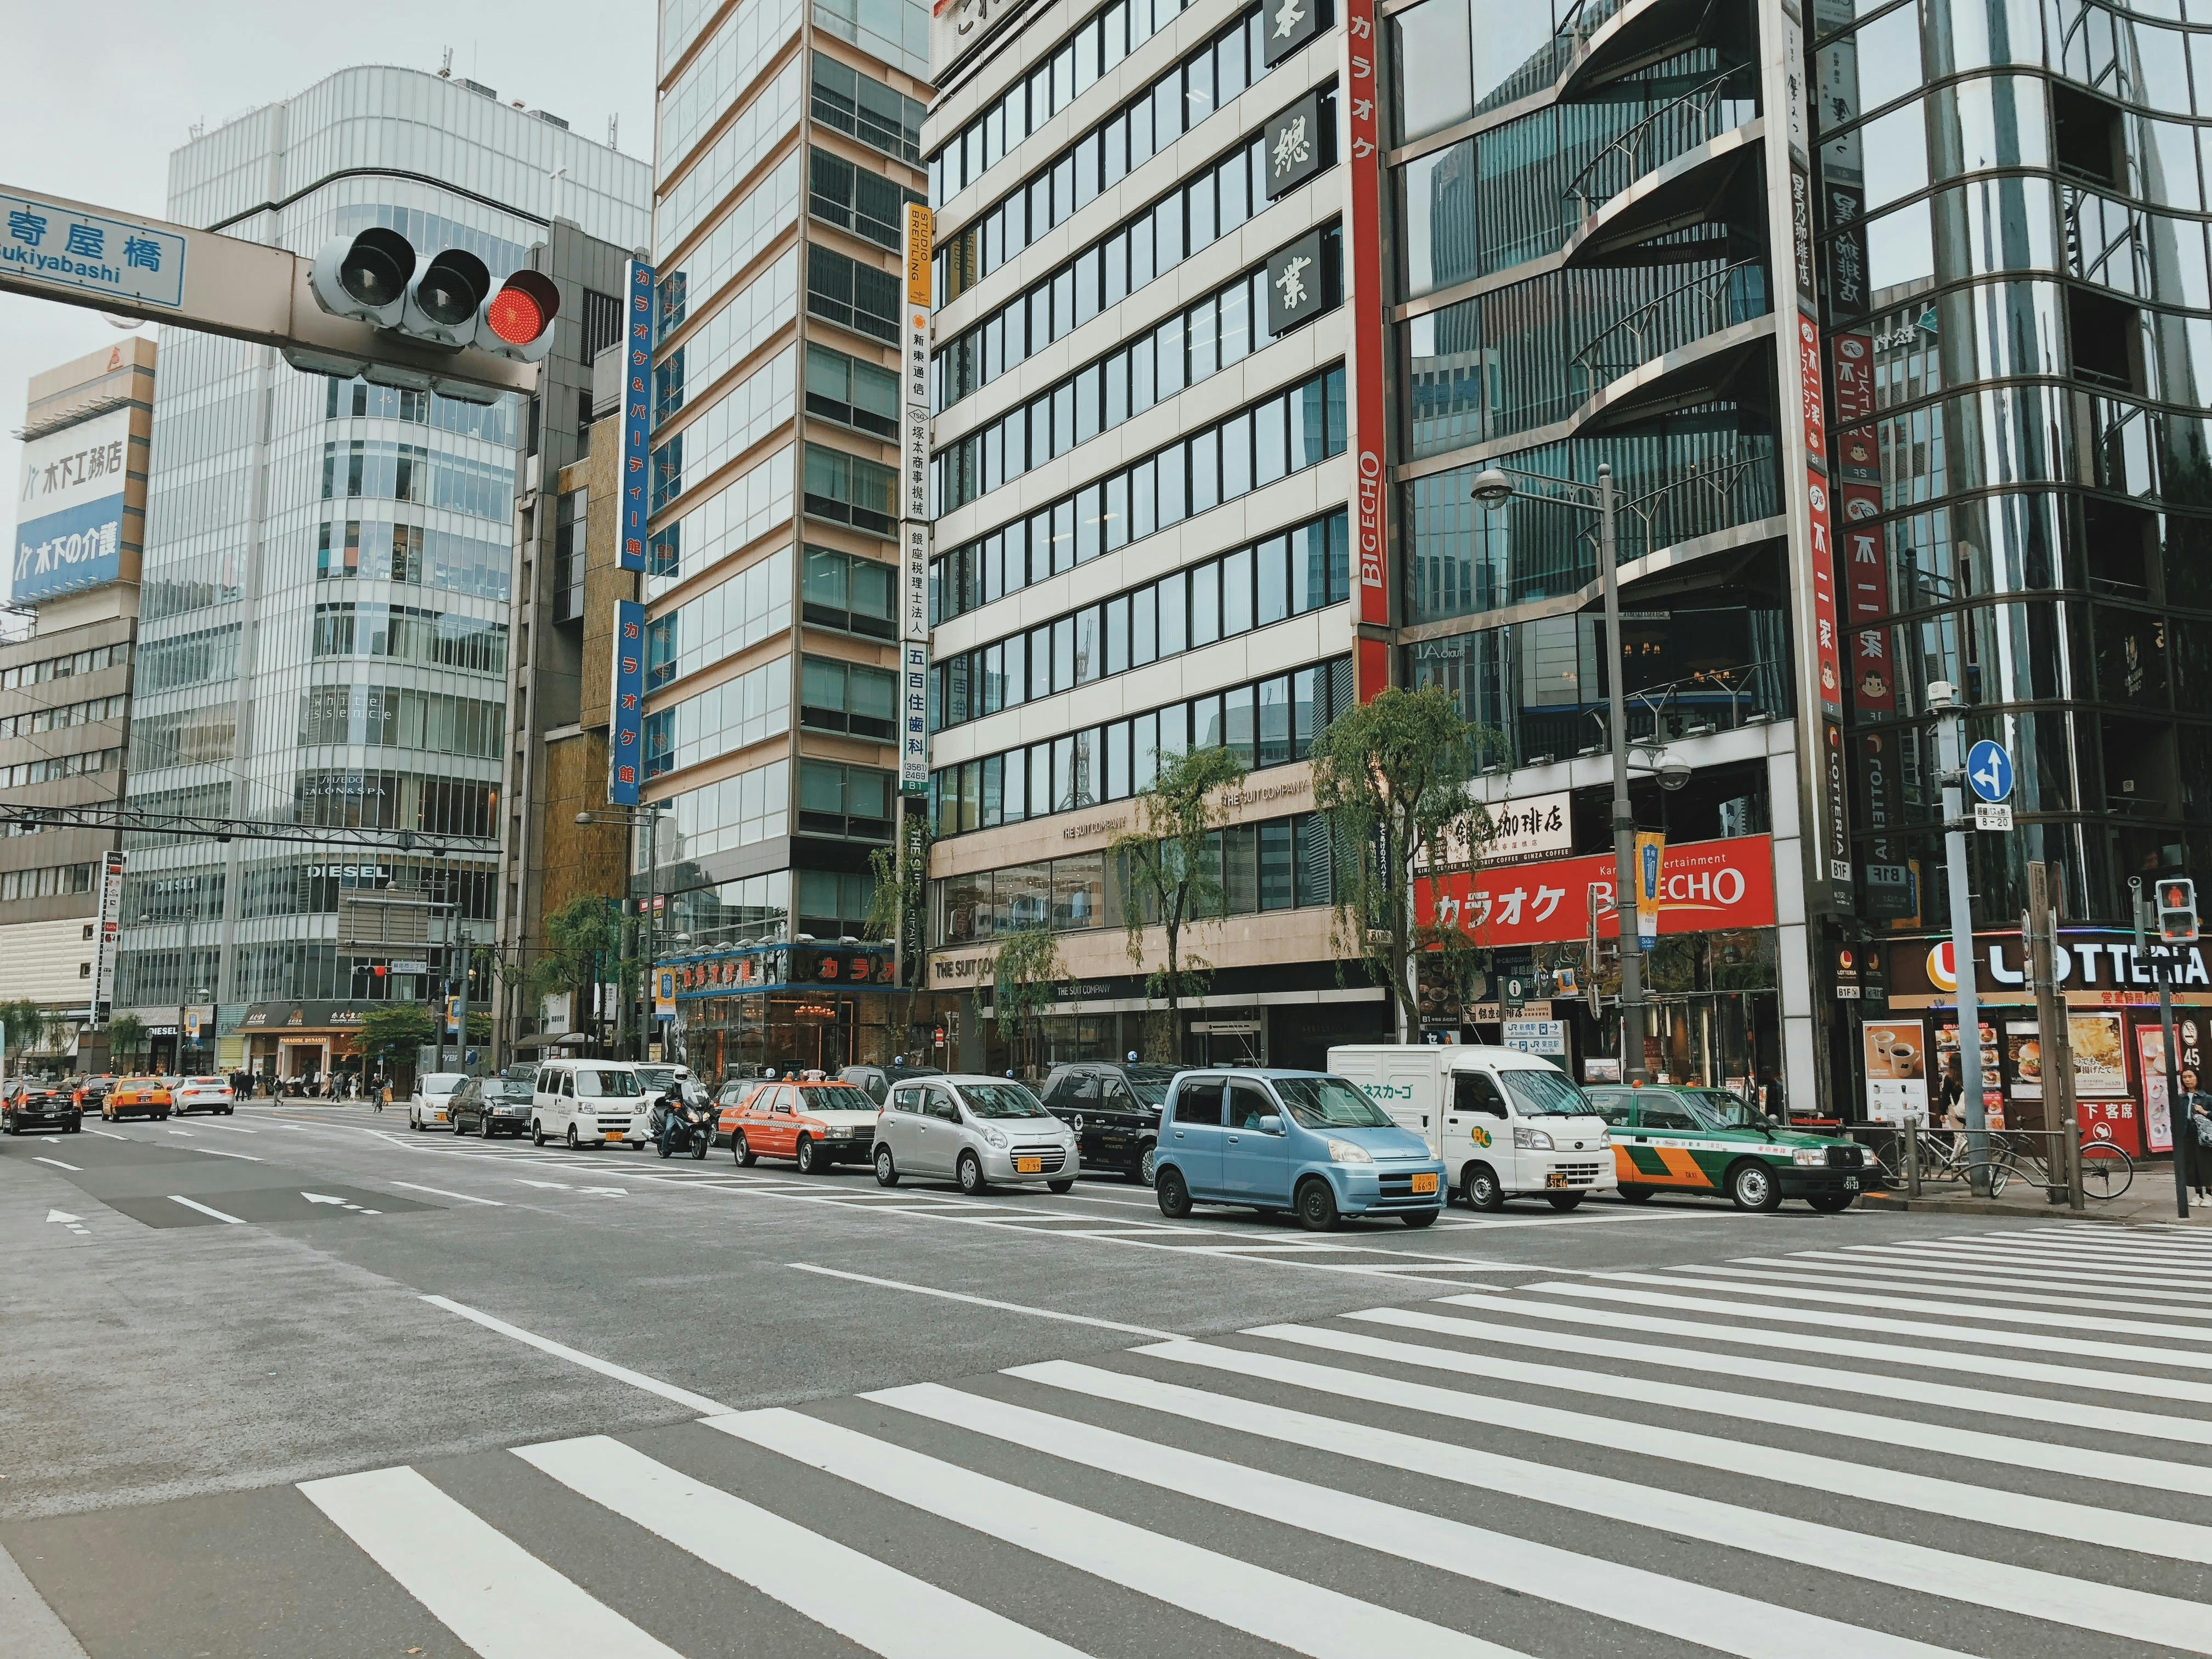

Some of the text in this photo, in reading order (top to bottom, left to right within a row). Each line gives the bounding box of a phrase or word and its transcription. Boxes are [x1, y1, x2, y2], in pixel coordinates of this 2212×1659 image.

[1351, 15, 1374, 158] カラオケ
[7, 210, 162, 272] 寄屋橋
[1791, 173, 1809, 287] 星乃珈琲店
[911, 210, 919, 281] BREITLING
[0, 244, 121, 283] ukiyabashi
[913, 334, 924, 396] 新東通信
[1808, 348, 1820, 427] 不二家
[626, 269, 650, 557] カラオケ&パーティー館
[912, 412, 925, 420] TSG
[43, 441, 123, 495] 木下工務店
[912, 426, 924, 516] 塚本商事機械
[1360, 450, 1382, 588] BIG ECHO
[34, 520, 119, 574] 木下の介護
[911, 532, 923, 634] 銀座税理士法人
[1813, 521, 1832, 650] 不二家
[315, 695, 377, 707] white
[618, 622, 639, 783] カラオケ館
[909, 650, 924, 755] 五百住歯科
[304, 709, 392, 720] essence
[904, 763, 927, 772] (3561)
[905, 771, 926, 780] 2469
[320, 776, 363, 785] SHISEIDO
[909, 782, 922, 790] B1
[1223, 793, 1238, 806] THE
[1262, 780, 1309, 799] COMPANY
[1831, 752, 1844, 855] LOTTERIA
[1063, 816, 1128, 839] THE SUIT COMPANY
[1455, 805, 1564, 847] 銀珈琲店
[1545, 849, 1569, 857] COFFEE
[1664, 853, 1726, 869] ertainment
[307, 866, 389, 878] DIESEL
[1833, 863, 1847, 878] B1F
[1435, 885, 1566, 929] カラオケ
[935, 961, 953, 978] THE
[956, 958, 977, 976] SUIT
[1058, 984, 1111, 996] THE SUIT COMPANY
[1839, 988, 1851, 996] B1F
[149, 1027, 178, 1036] DIESEL
[2184, 1048, 2200, 1066] 45
[1473, 1128, 1491, 1147] BC
[1418, 1181, 1435, 1190] 66-91
[1846, 1181, 1859, 1189] 51-23
